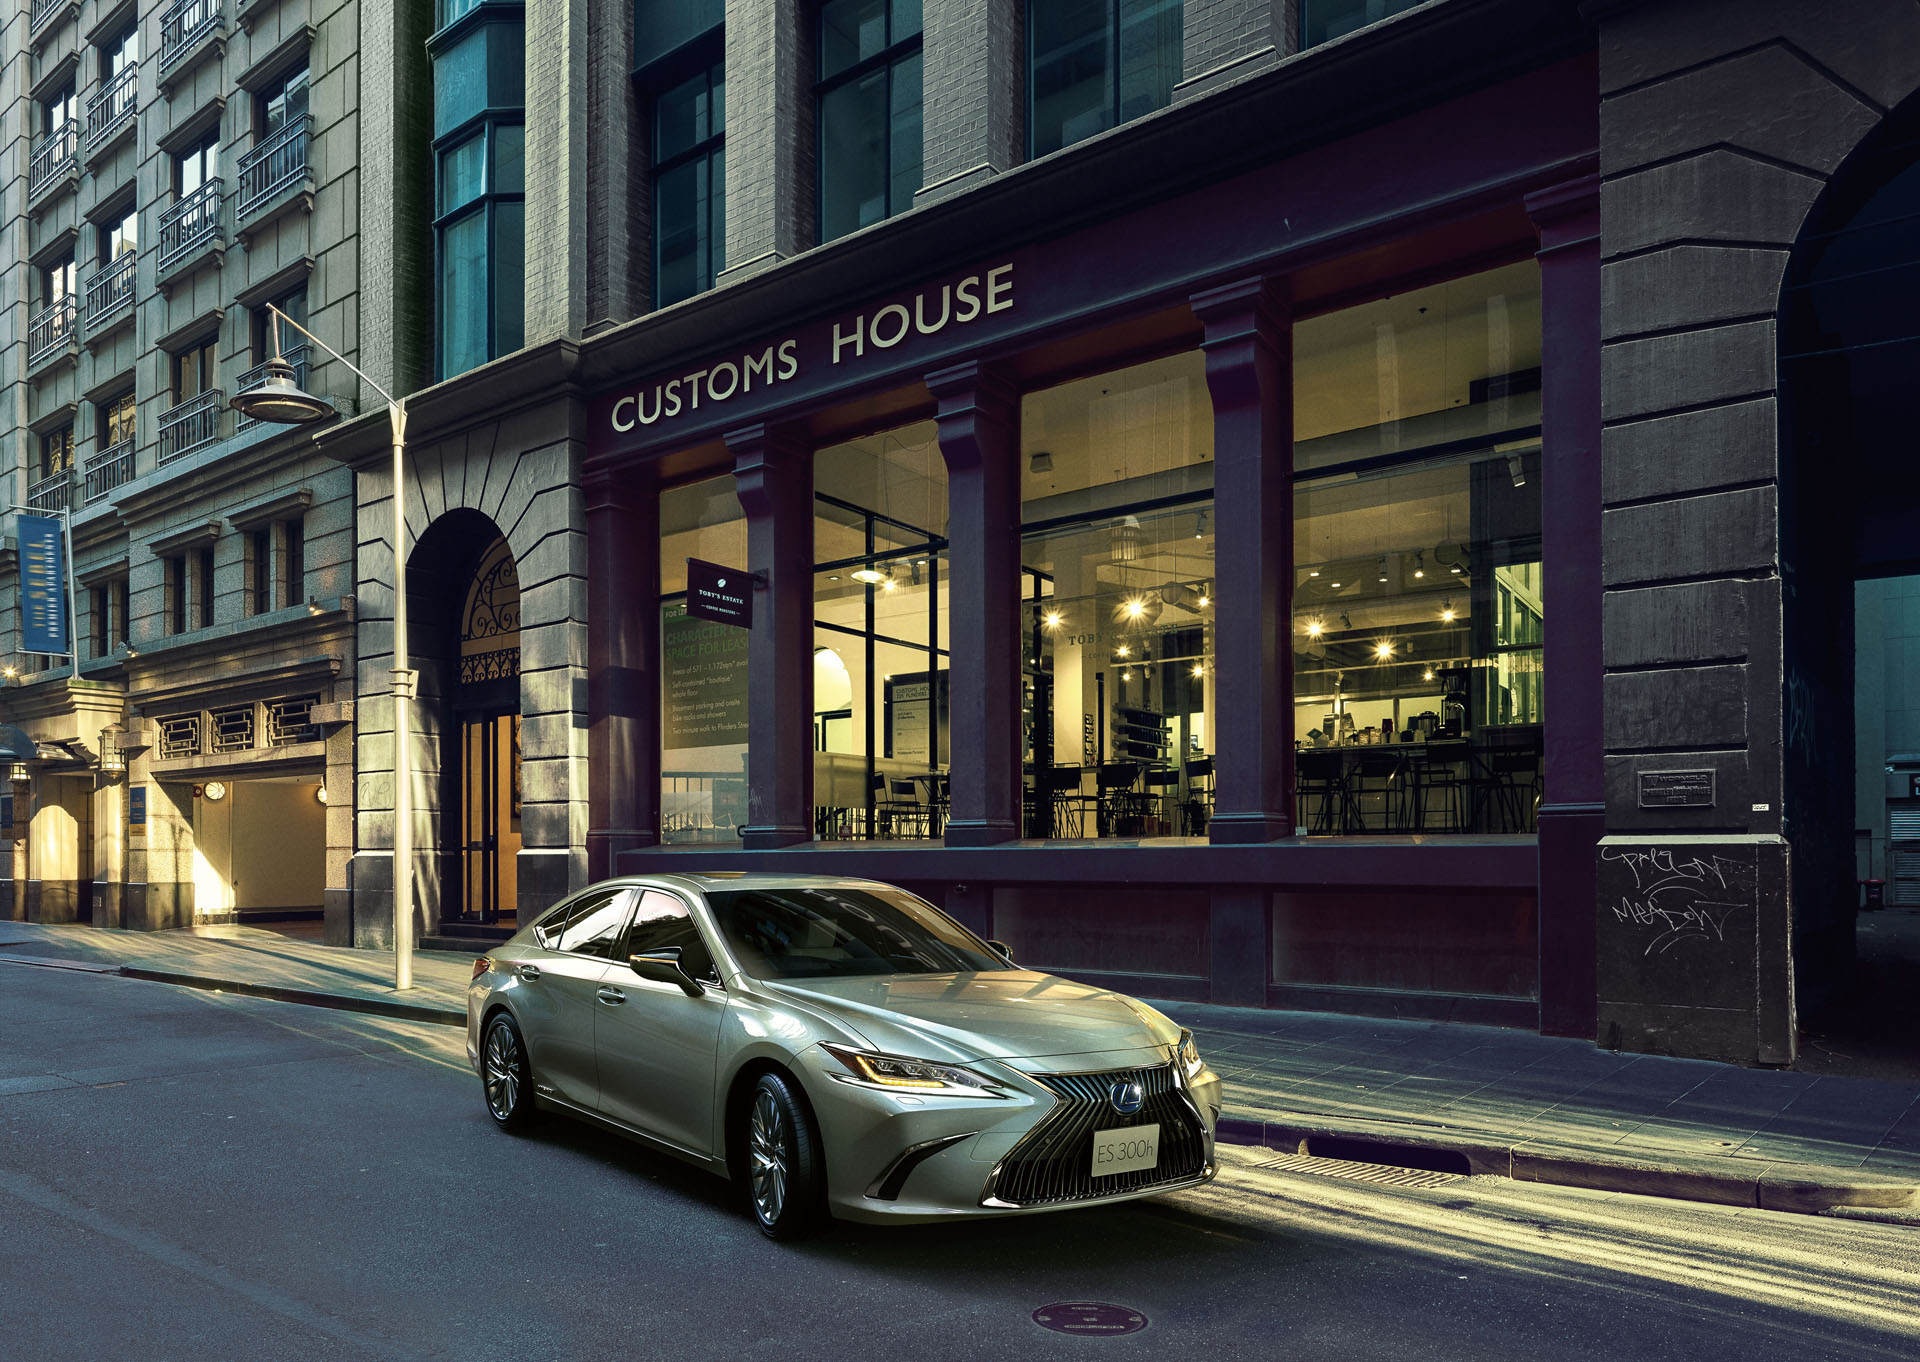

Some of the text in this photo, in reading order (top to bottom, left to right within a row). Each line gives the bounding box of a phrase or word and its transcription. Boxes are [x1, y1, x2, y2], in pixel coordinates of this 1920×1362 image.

[612, 263, 1013, 433] CUSTOMS HOUSE
[699, 589, 744, 604] TOBY'S ESTATE
[699, 641, 719, 656] FOR
[1097, 1139, 1153, 1164] ES 300h
